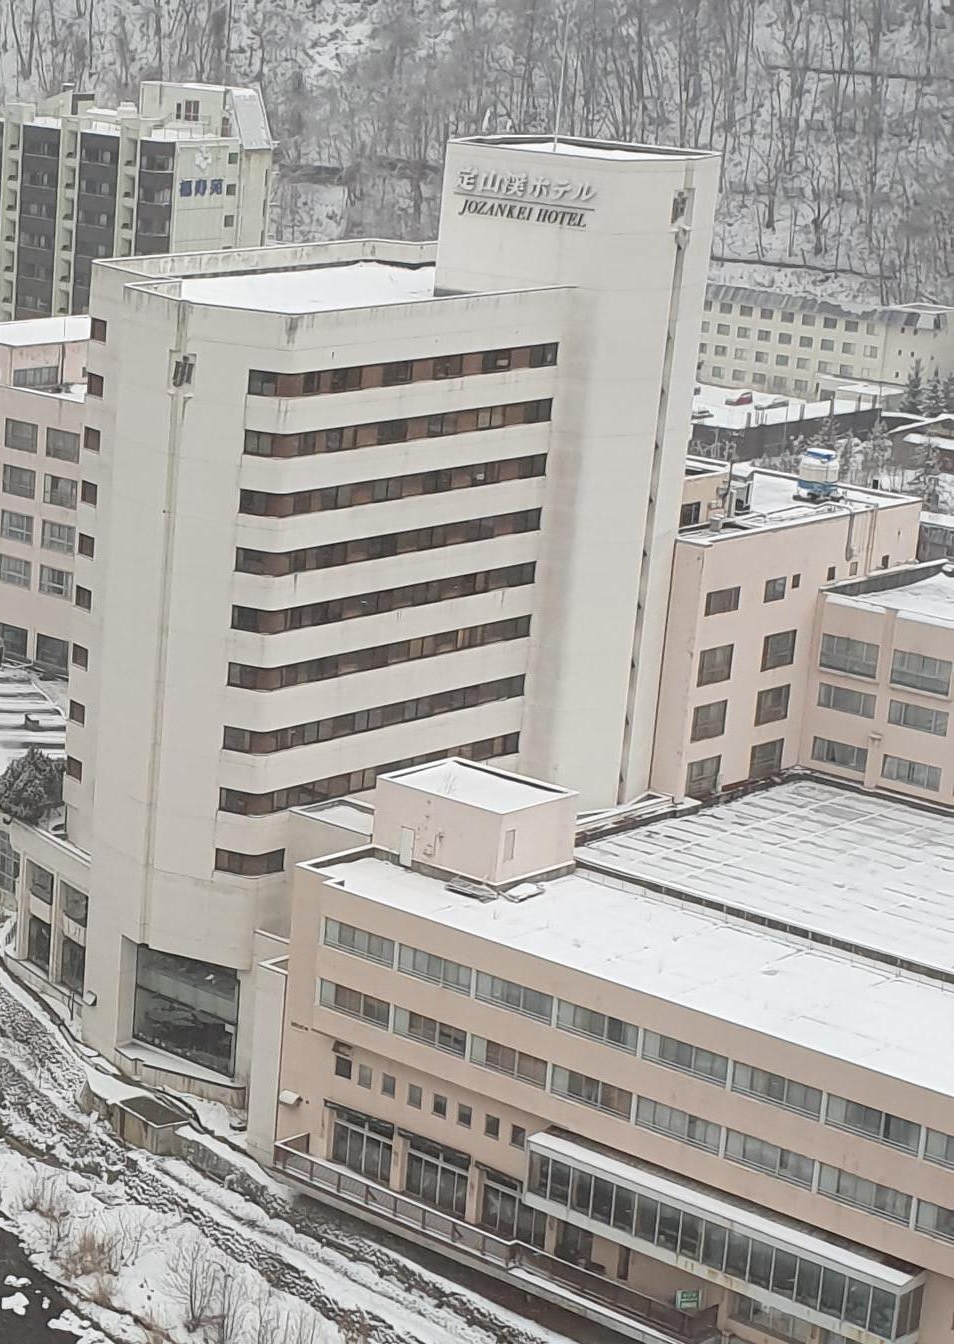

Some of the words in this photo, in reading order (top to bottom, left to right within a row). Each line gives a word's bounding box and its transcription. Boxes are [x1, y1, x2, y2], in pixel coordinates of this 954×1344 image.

[457, 167, 597, 202] 定山渓ホテル
[458, 199, 534, 222] JOZANKEI
[535, 208, 587, 228] HOTEL
